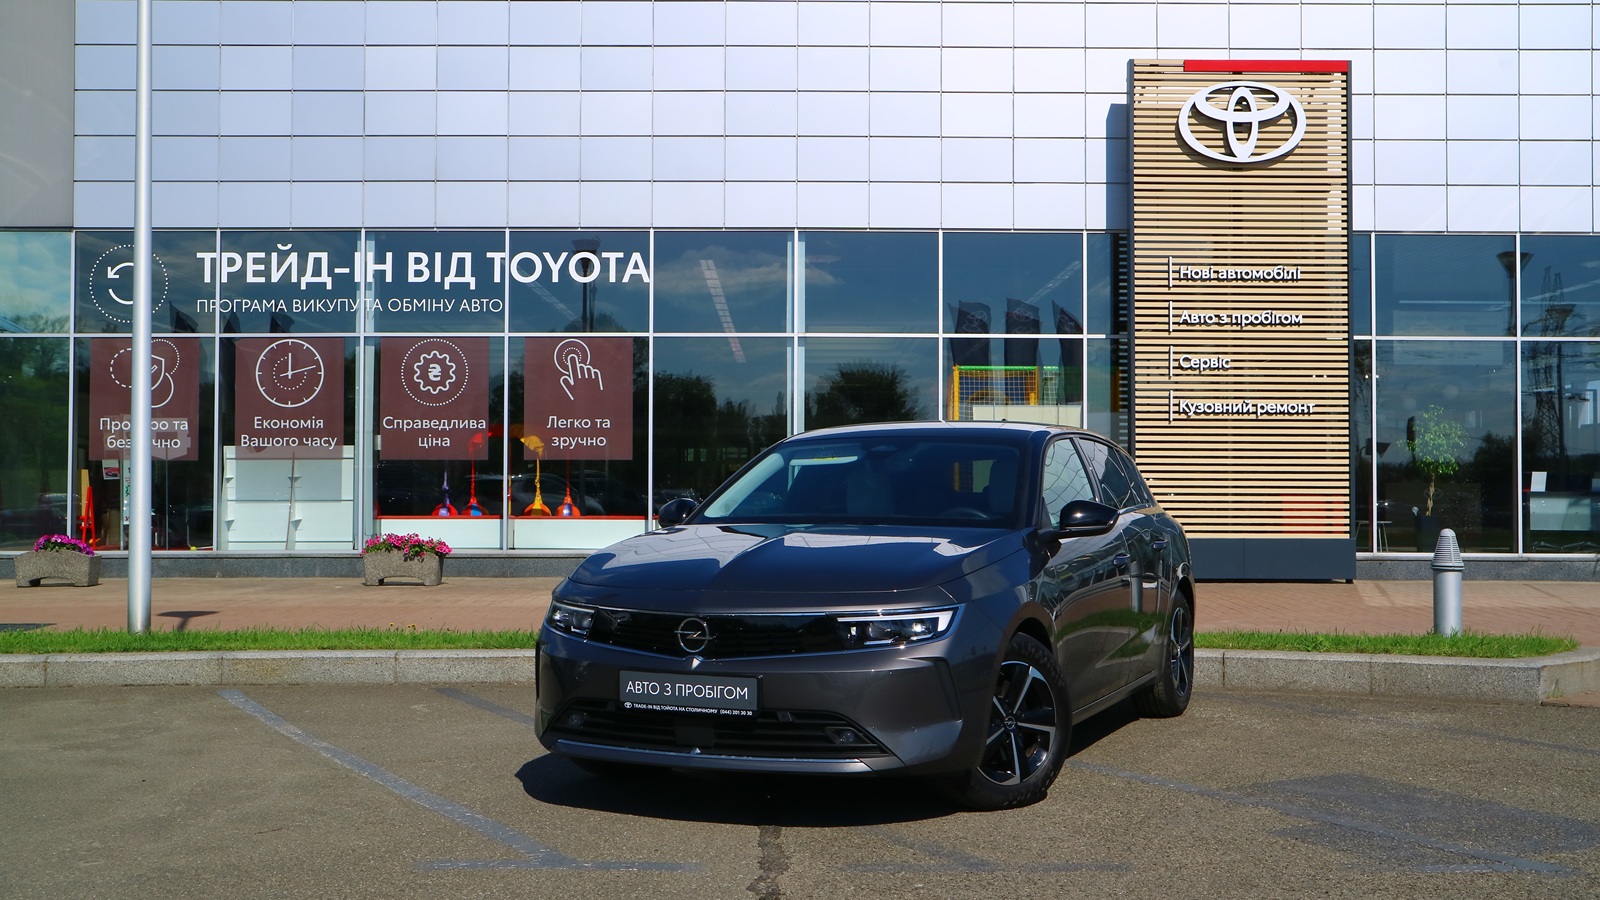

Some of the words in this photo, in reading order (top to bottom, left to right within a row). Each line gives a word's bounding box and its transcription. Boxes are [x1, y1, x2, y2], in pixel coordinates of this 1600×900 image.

[196, 243, 393, 291] ТРЕЙД-ІН
[407, 251, 476, 291] ВІД
[486, 251, 650, 284] TOYOTA
[1180, 265, 1213, 280] Нові
[1218, 265, 1301, 280] автомобілі
[197, 299, 287, 313] ПРОГРАМА
[292, 298, 361, 313] ВИКУПУ
[364, 298, 383, 312] ТА
[387, 298, 456, 313] ОБМІНУ
[459, 298, 503, 312] АВТО
[1180, 310, 1215, 324] Авто
[1219, 314, 1227, 324] з
[1232, 310, 1303, 328] пробігом
[1180, 355, 1231, 372] Сервіс
[1180, 399, 1252, 416] Кузовний
[1257, 402, 1315, 416] ремонт
[173, 421, 189, 431] та
[254, 416, 324, 429] Економія
[382, 416, 486, 432] Справедлива
[546, 415, 591, 429] Легко
[595, 418, 611, 429] та
[107, 435, 181, 449] безчно
[241, 434, 299, 447] Вашого
[303, 437, 337, 450] часу
[418, 434, 450, 449] ціна
[551, 436, 607, 450] зручно
[625, 680, 660, 696] АВТО
[675, 683, 748, 700] ПРОБІГОМ
